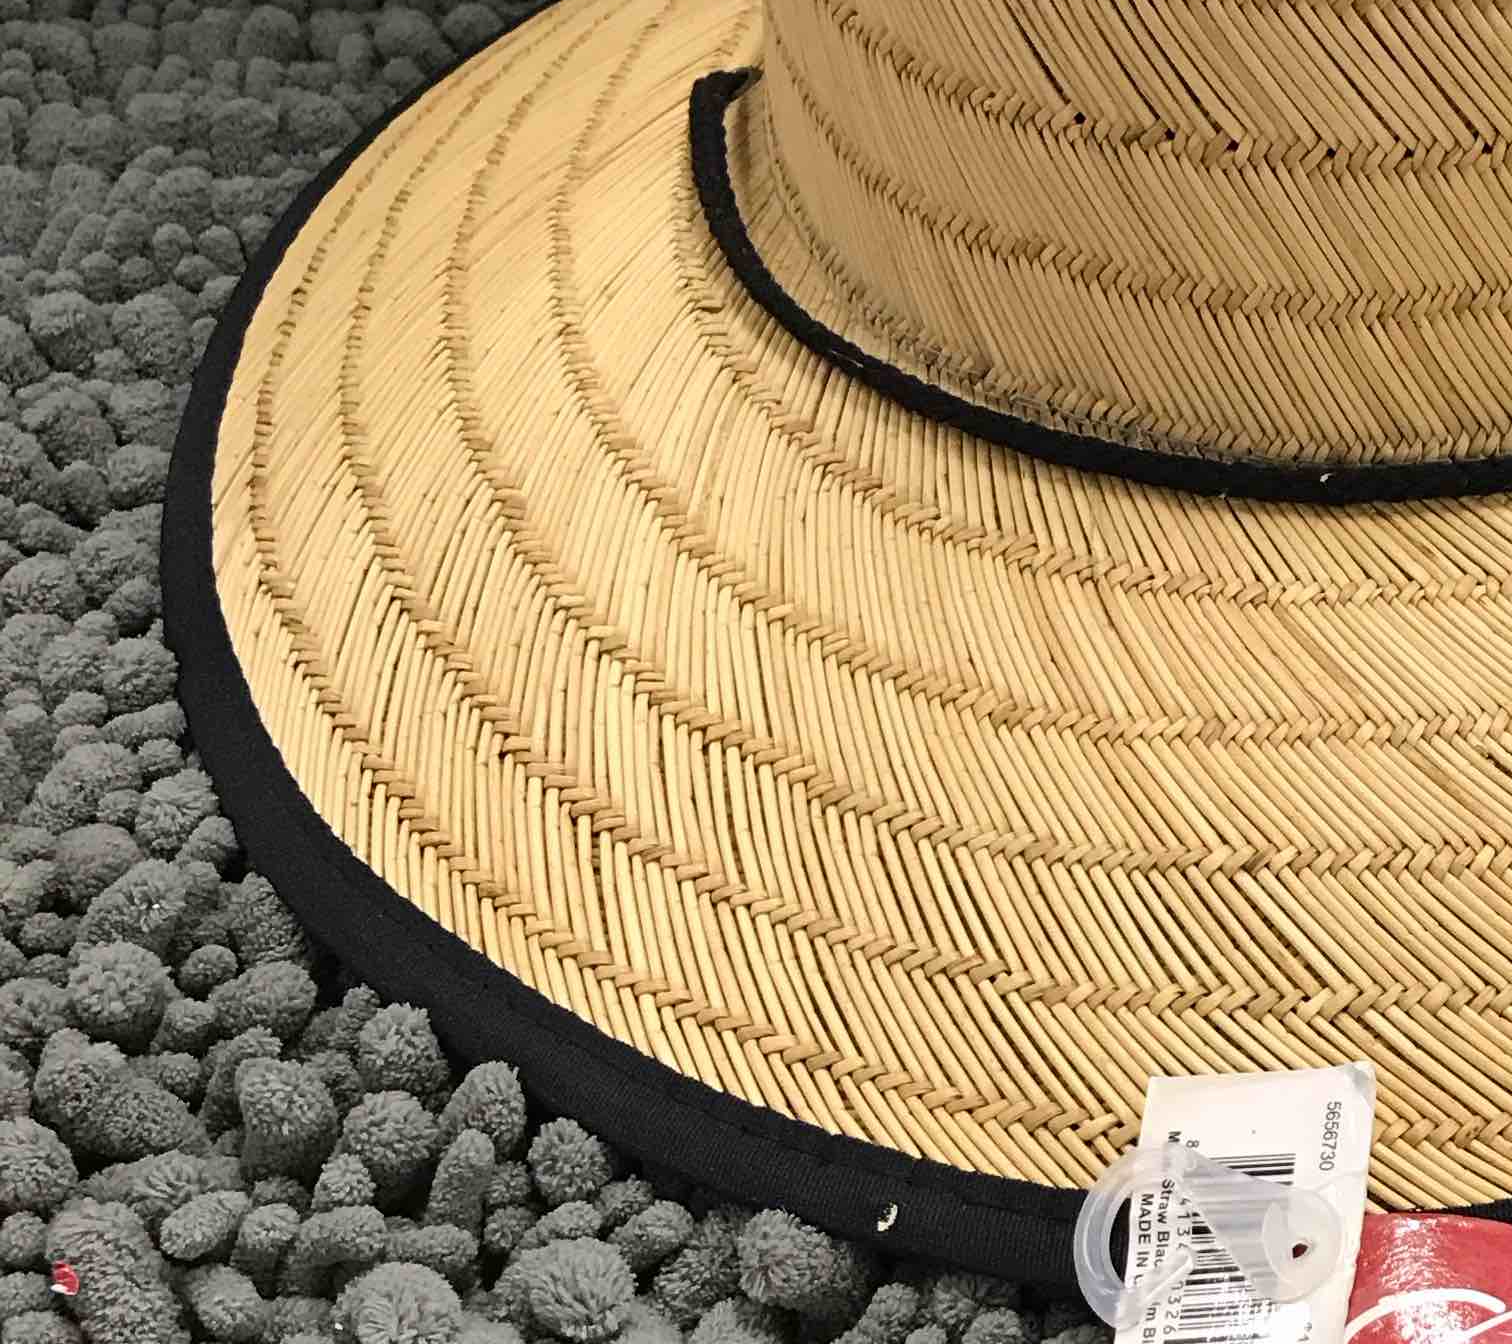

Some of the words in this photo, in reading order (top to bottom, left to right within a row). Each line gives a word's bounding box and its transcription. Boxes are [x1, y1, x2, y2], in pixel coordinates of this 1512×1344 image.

[1319, 1099, 1343, 1172] 5656730
[1137, 1193, 1155, 1245] MADE
[1157, 1178, 1176, 1224] Straw
[1135, 1250, 1150, 1268] IN
[1154, 1230, 1170, 1268] Blac
